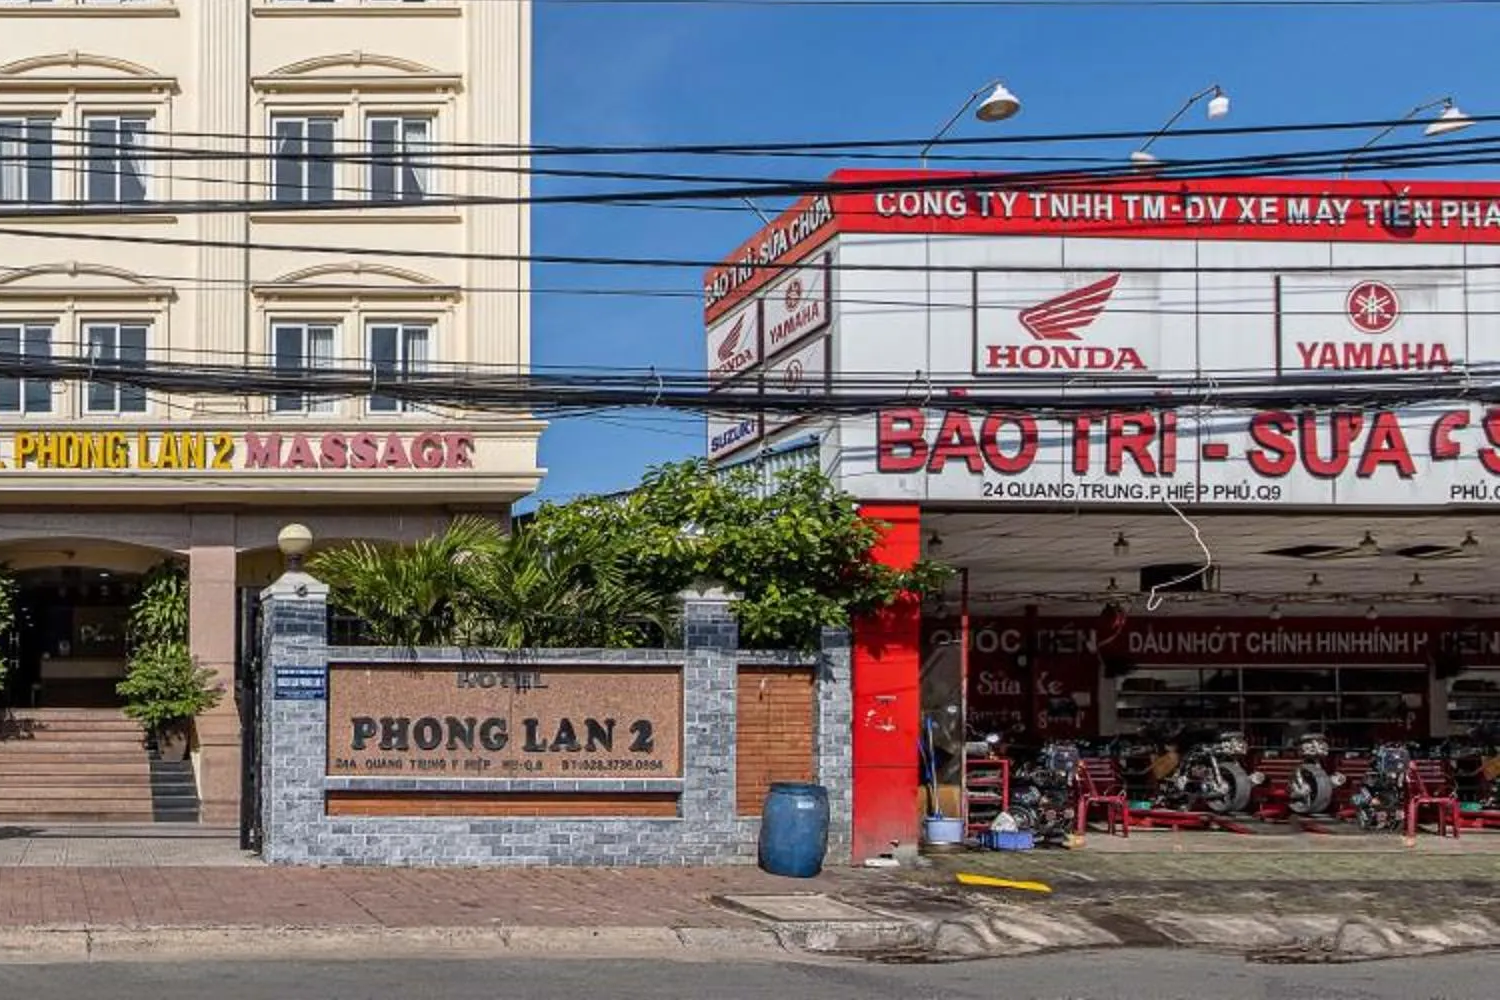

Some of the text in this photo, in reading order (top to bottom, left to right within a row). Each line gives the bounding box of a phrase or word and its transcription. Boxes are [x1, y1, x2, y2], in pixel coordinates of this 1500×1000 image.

[975, 191, 1020, 218] TY
[1027, 191, 1113, 220] TNHH
[1238, 197, 1279, 224] XE
[769, 298, 820, 345] YAMAHA
[985, 345, 1147, 369] HONDA
[1296, 341, 1451, 371] YAMAHA
[13, 431, 130, 469] PHONG
[137, 431, 207, 469] LAN
[211, 433, 235, 470] 2
[244, 431, 476, 469] MASSAGE
[710, 418, 755, 453] SUZUKI
[983, 481, 1004, 497] 24
[350, 716, 656, 753] PHONG LAN 2
